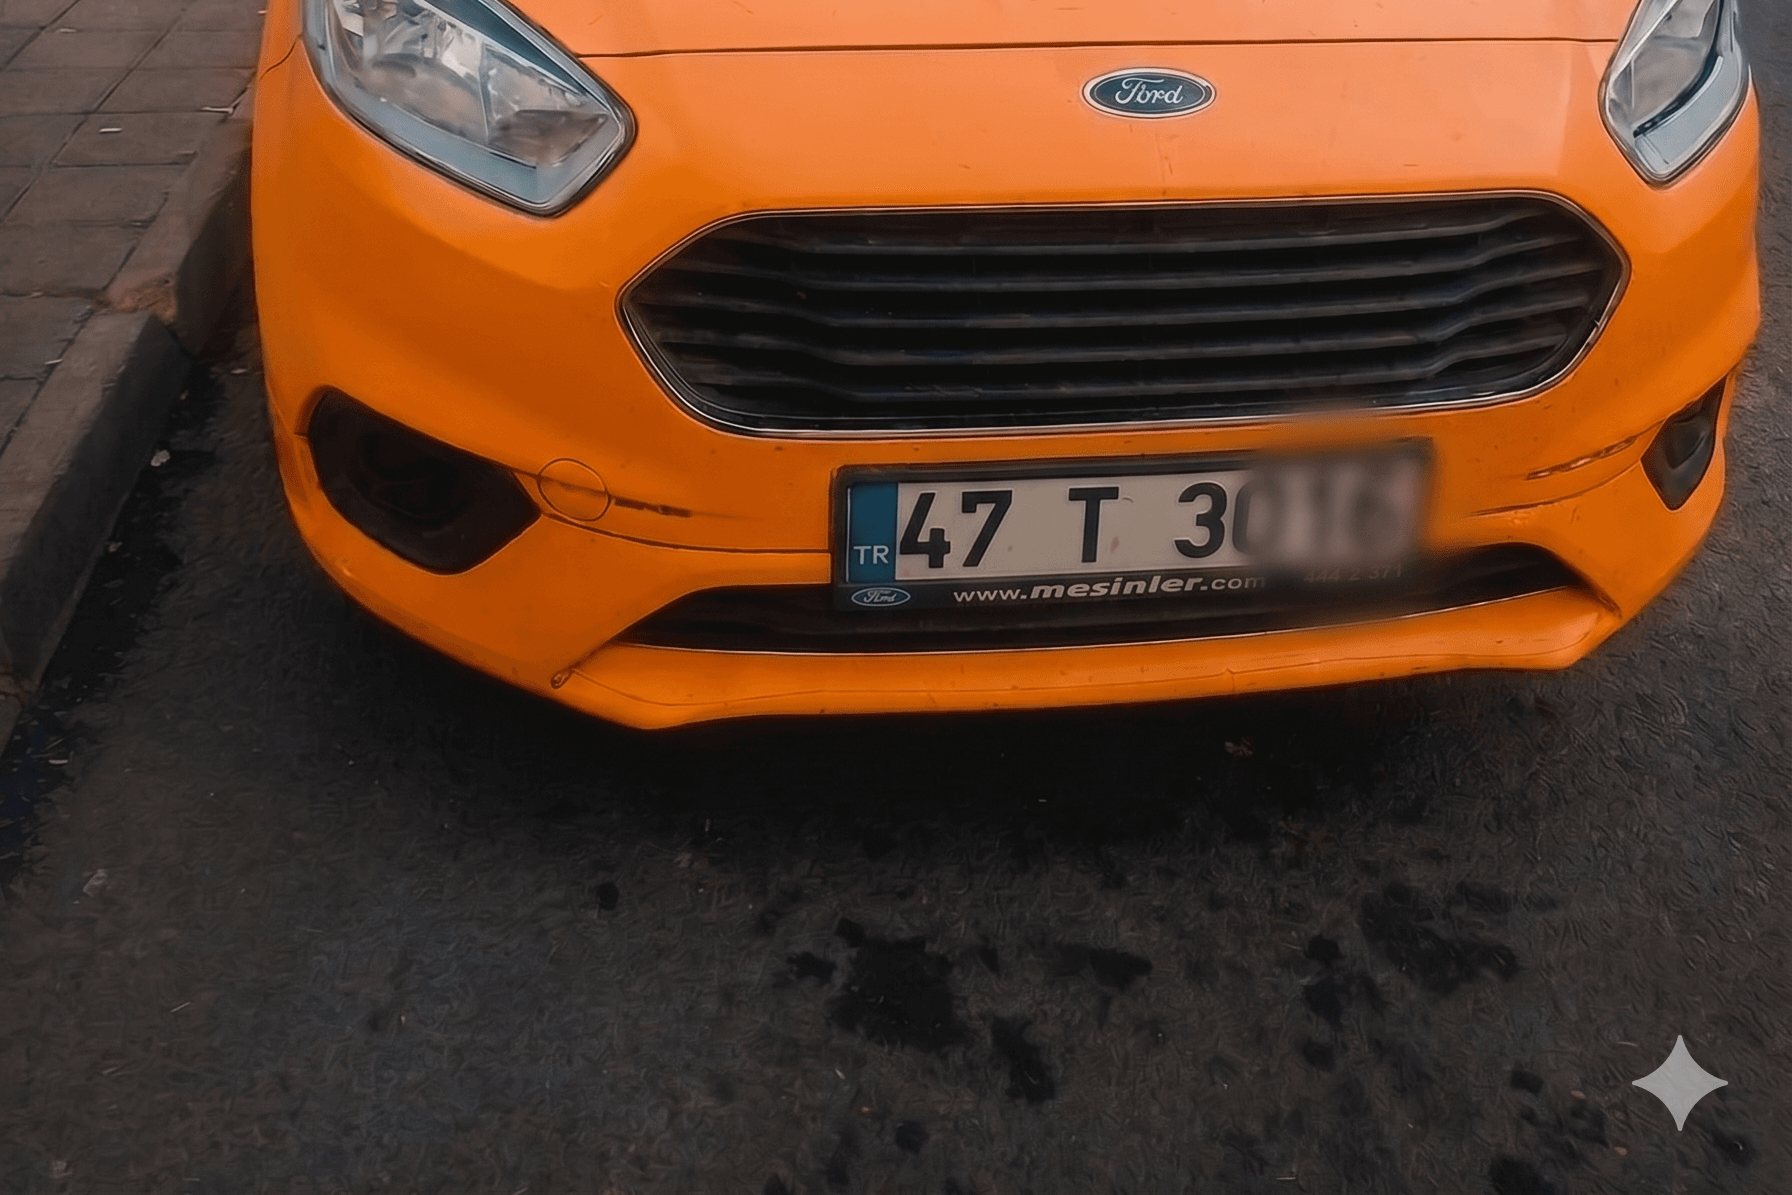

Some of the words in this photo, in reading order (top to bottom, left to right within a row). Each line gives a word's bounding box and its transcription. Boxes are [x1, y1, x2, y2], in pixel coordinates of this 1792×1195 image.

[1115, 77, 1183, 104] Ford
[900, 490, 1013, 569] 47
[1068, 486, 1119, 563] T
[854, 545, 889, 565] TR
[953, 575, 1265, 603] www.mesinler.com
